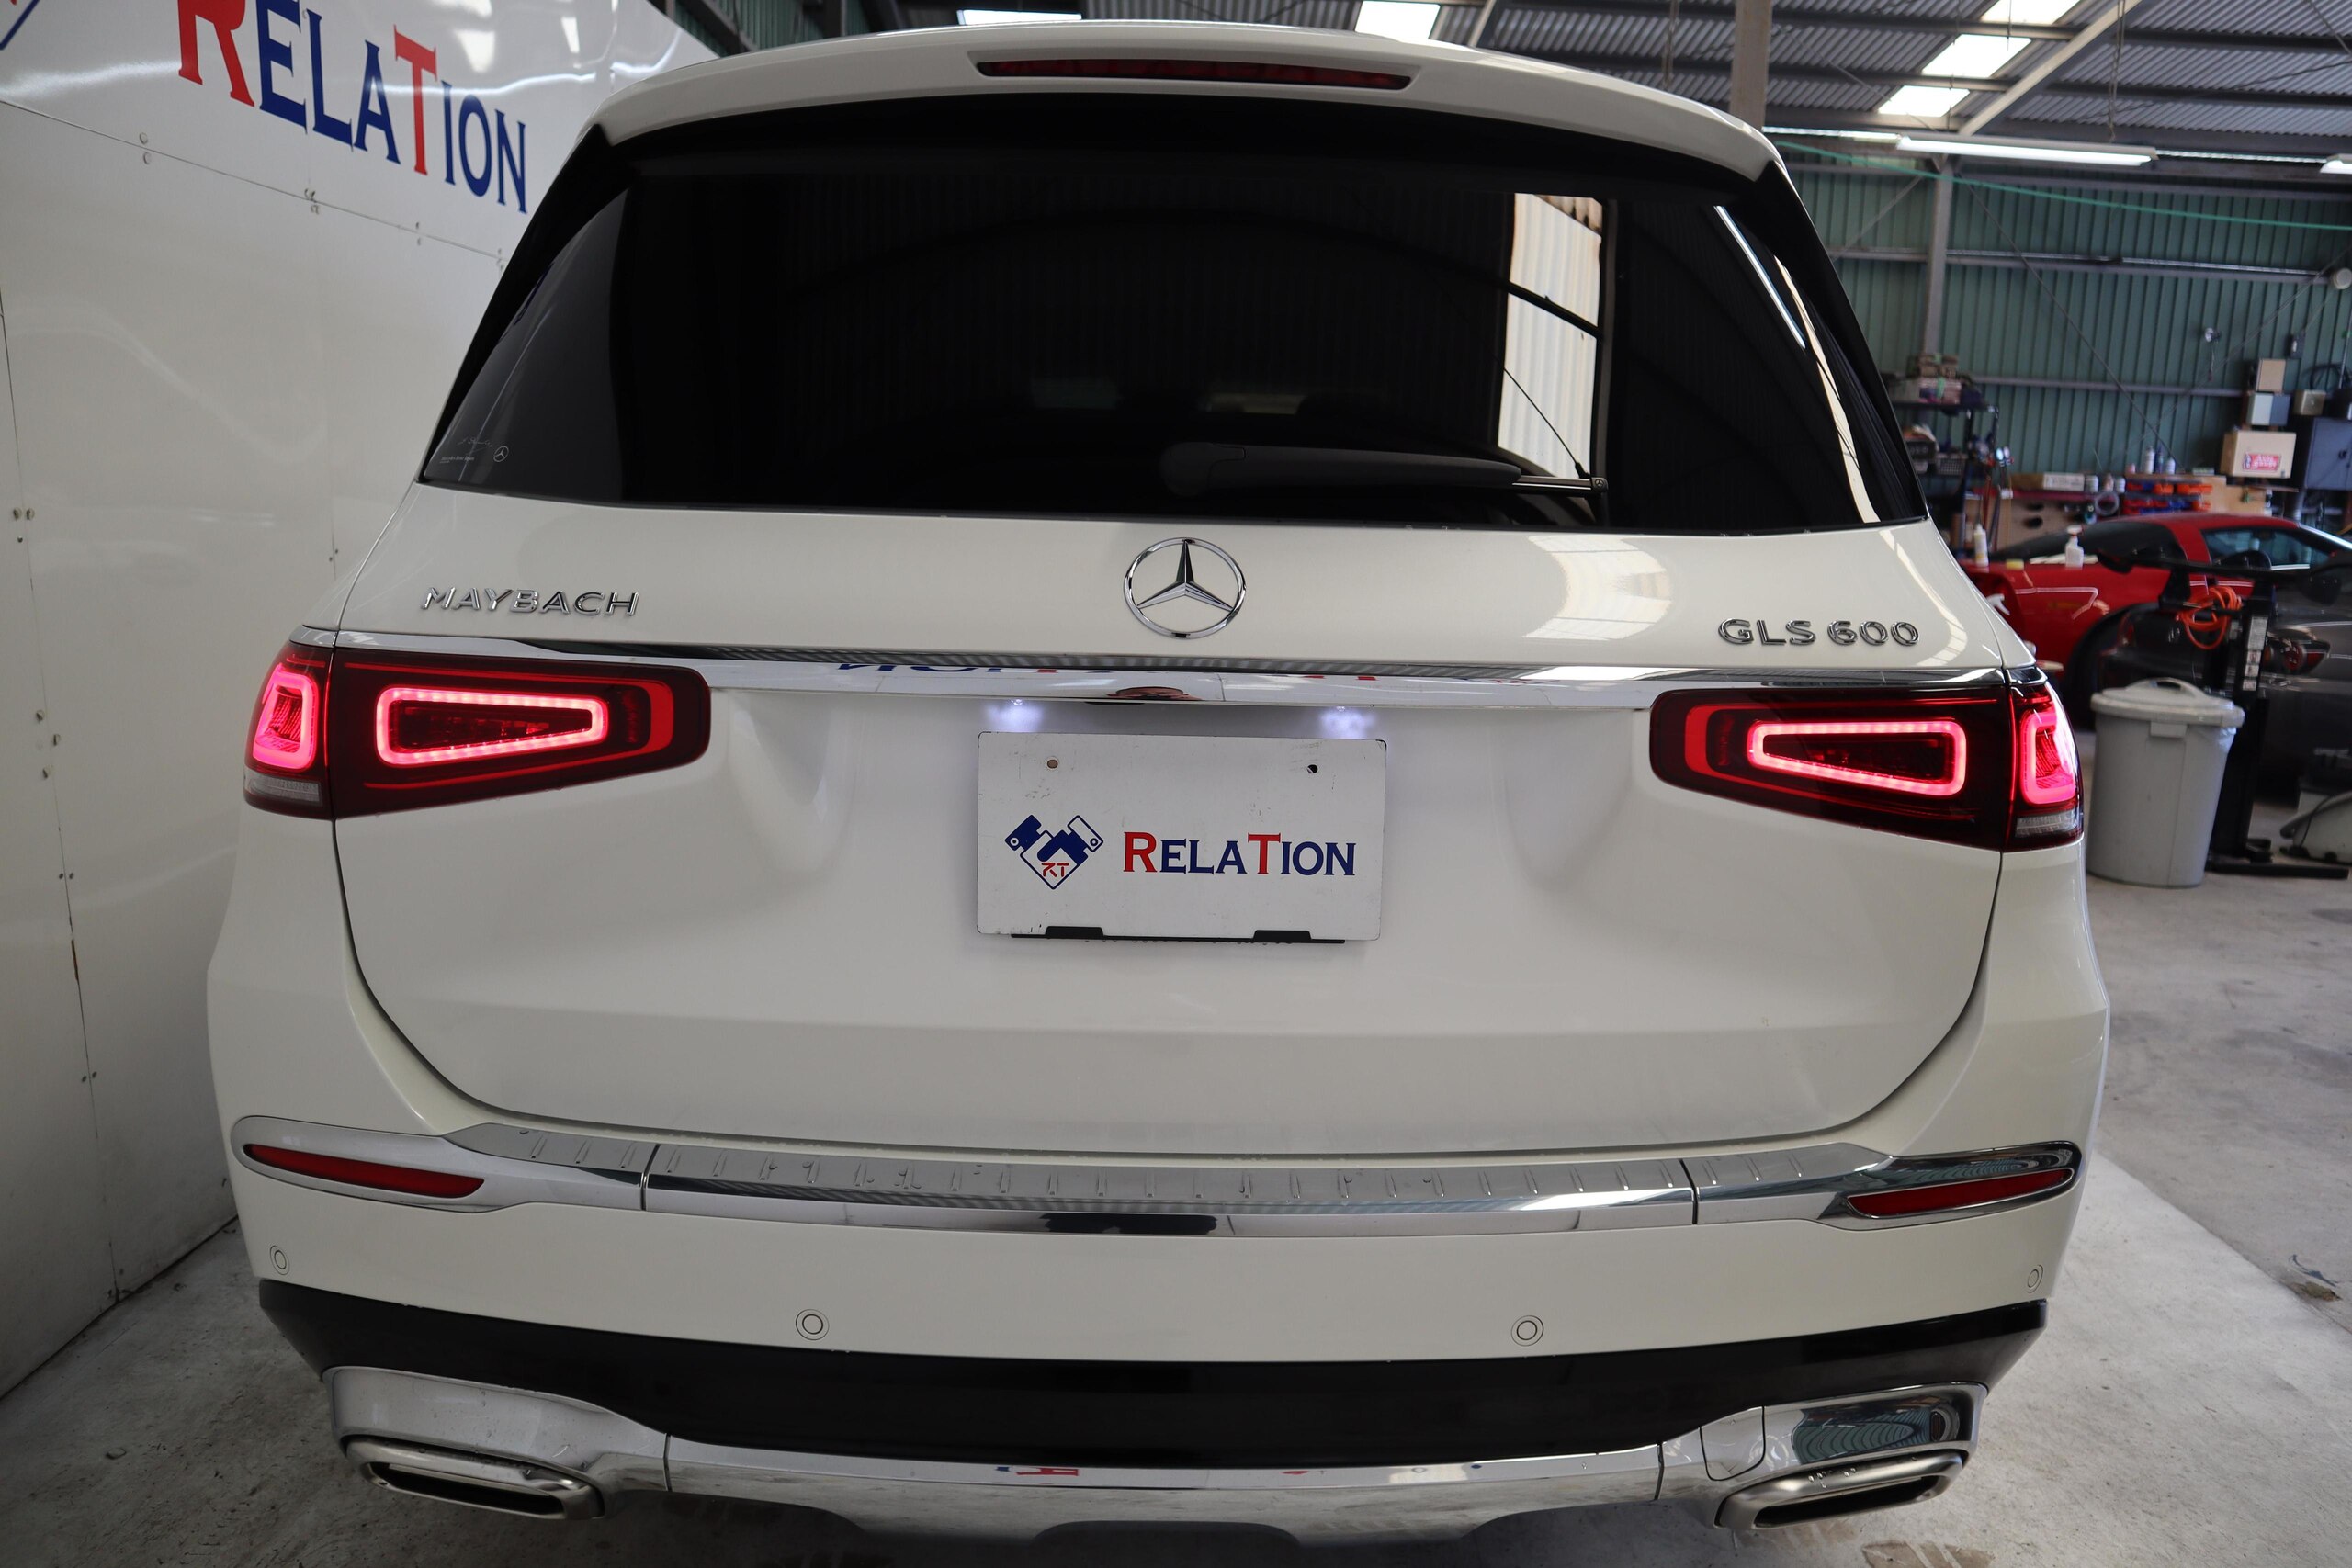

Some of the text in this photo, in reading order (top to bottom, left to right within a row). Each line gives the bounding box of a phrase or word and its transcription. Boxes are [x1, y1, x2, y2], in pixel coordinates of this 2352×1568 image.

[420, 586, 639, 616] MAYBACH
[1717, 618, 1920, 647] GLS 600
[1123, 831, 1357, 875] RELATION
[1041, 862, 1069, 877] RT
